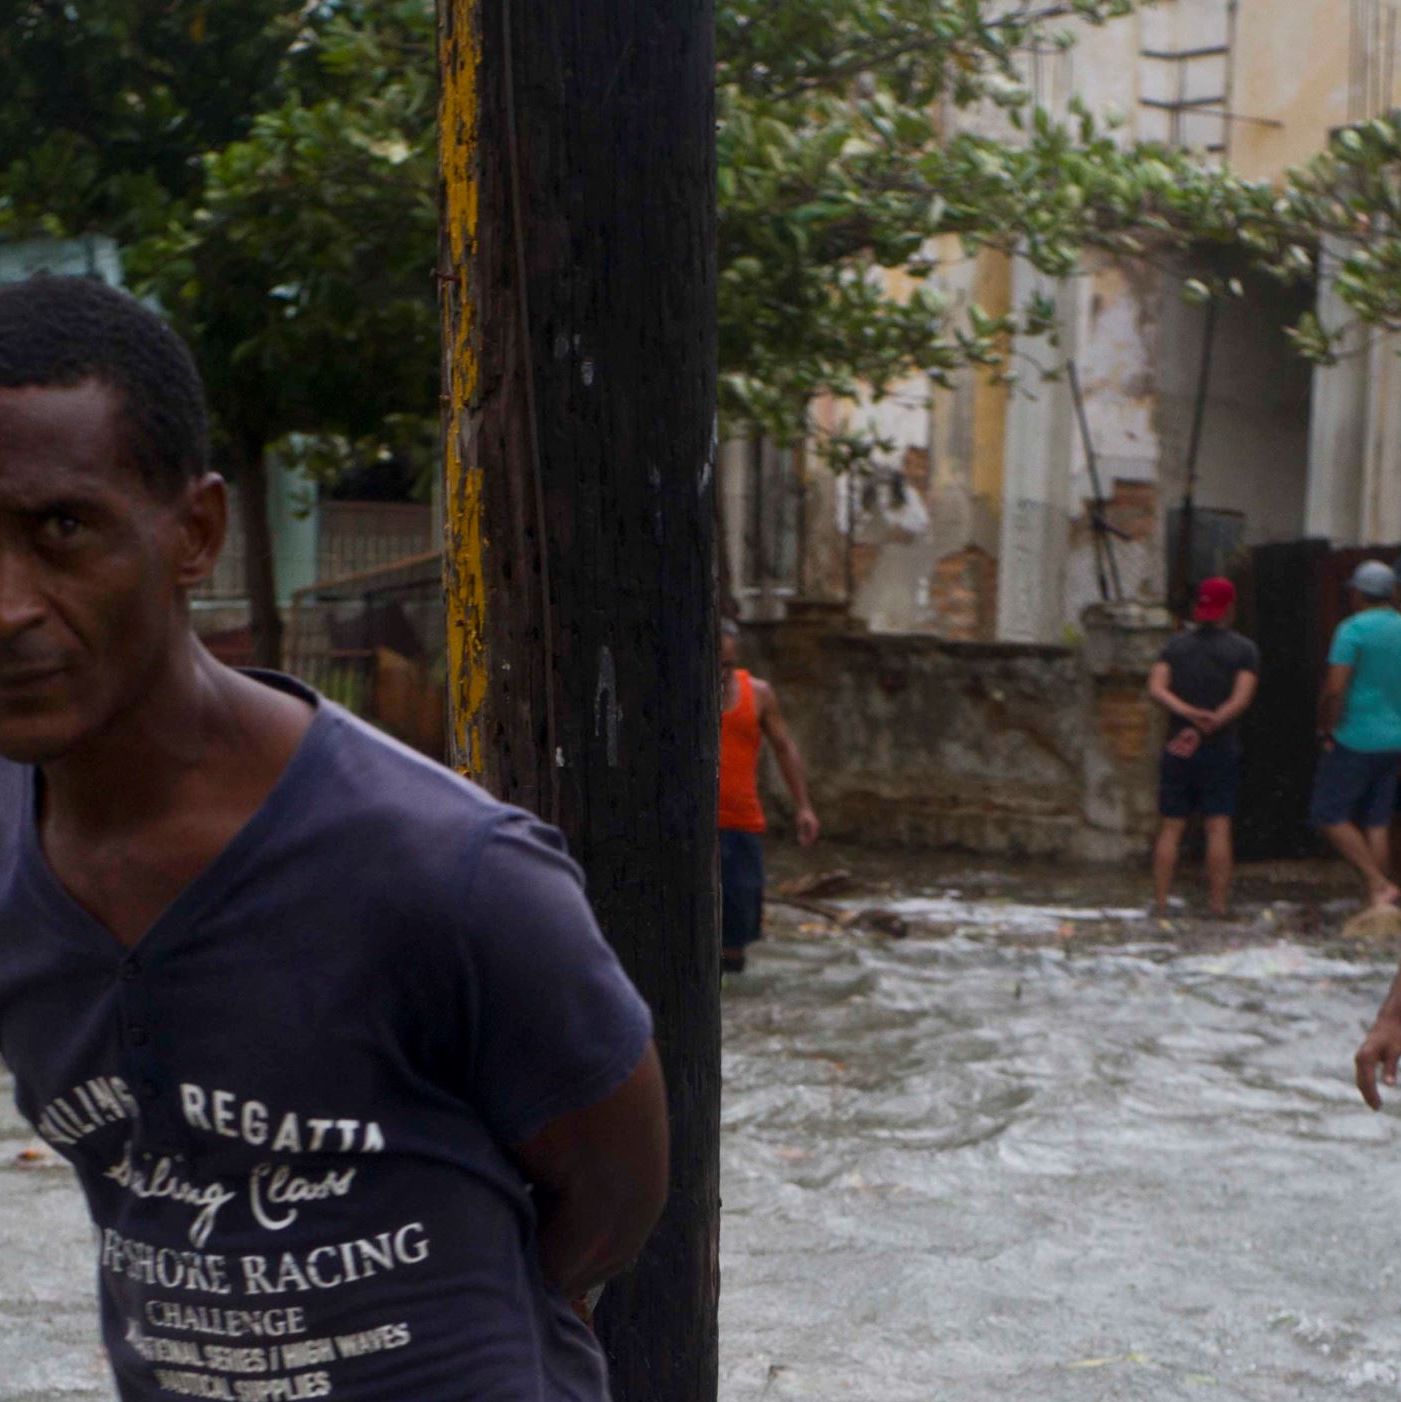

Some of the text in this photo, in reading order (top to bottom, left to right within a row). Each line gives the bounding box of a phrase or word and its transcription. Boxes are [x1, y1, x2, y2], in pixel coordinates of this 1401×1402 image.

[38, 1075, 386, 1153] AILING REGATTA
[249, 1162, 356, 1231] Class
[101, 1222, 430, 1296] FFSHORE RACING
[145, 1299, 308, 1338] CHALLENGE
